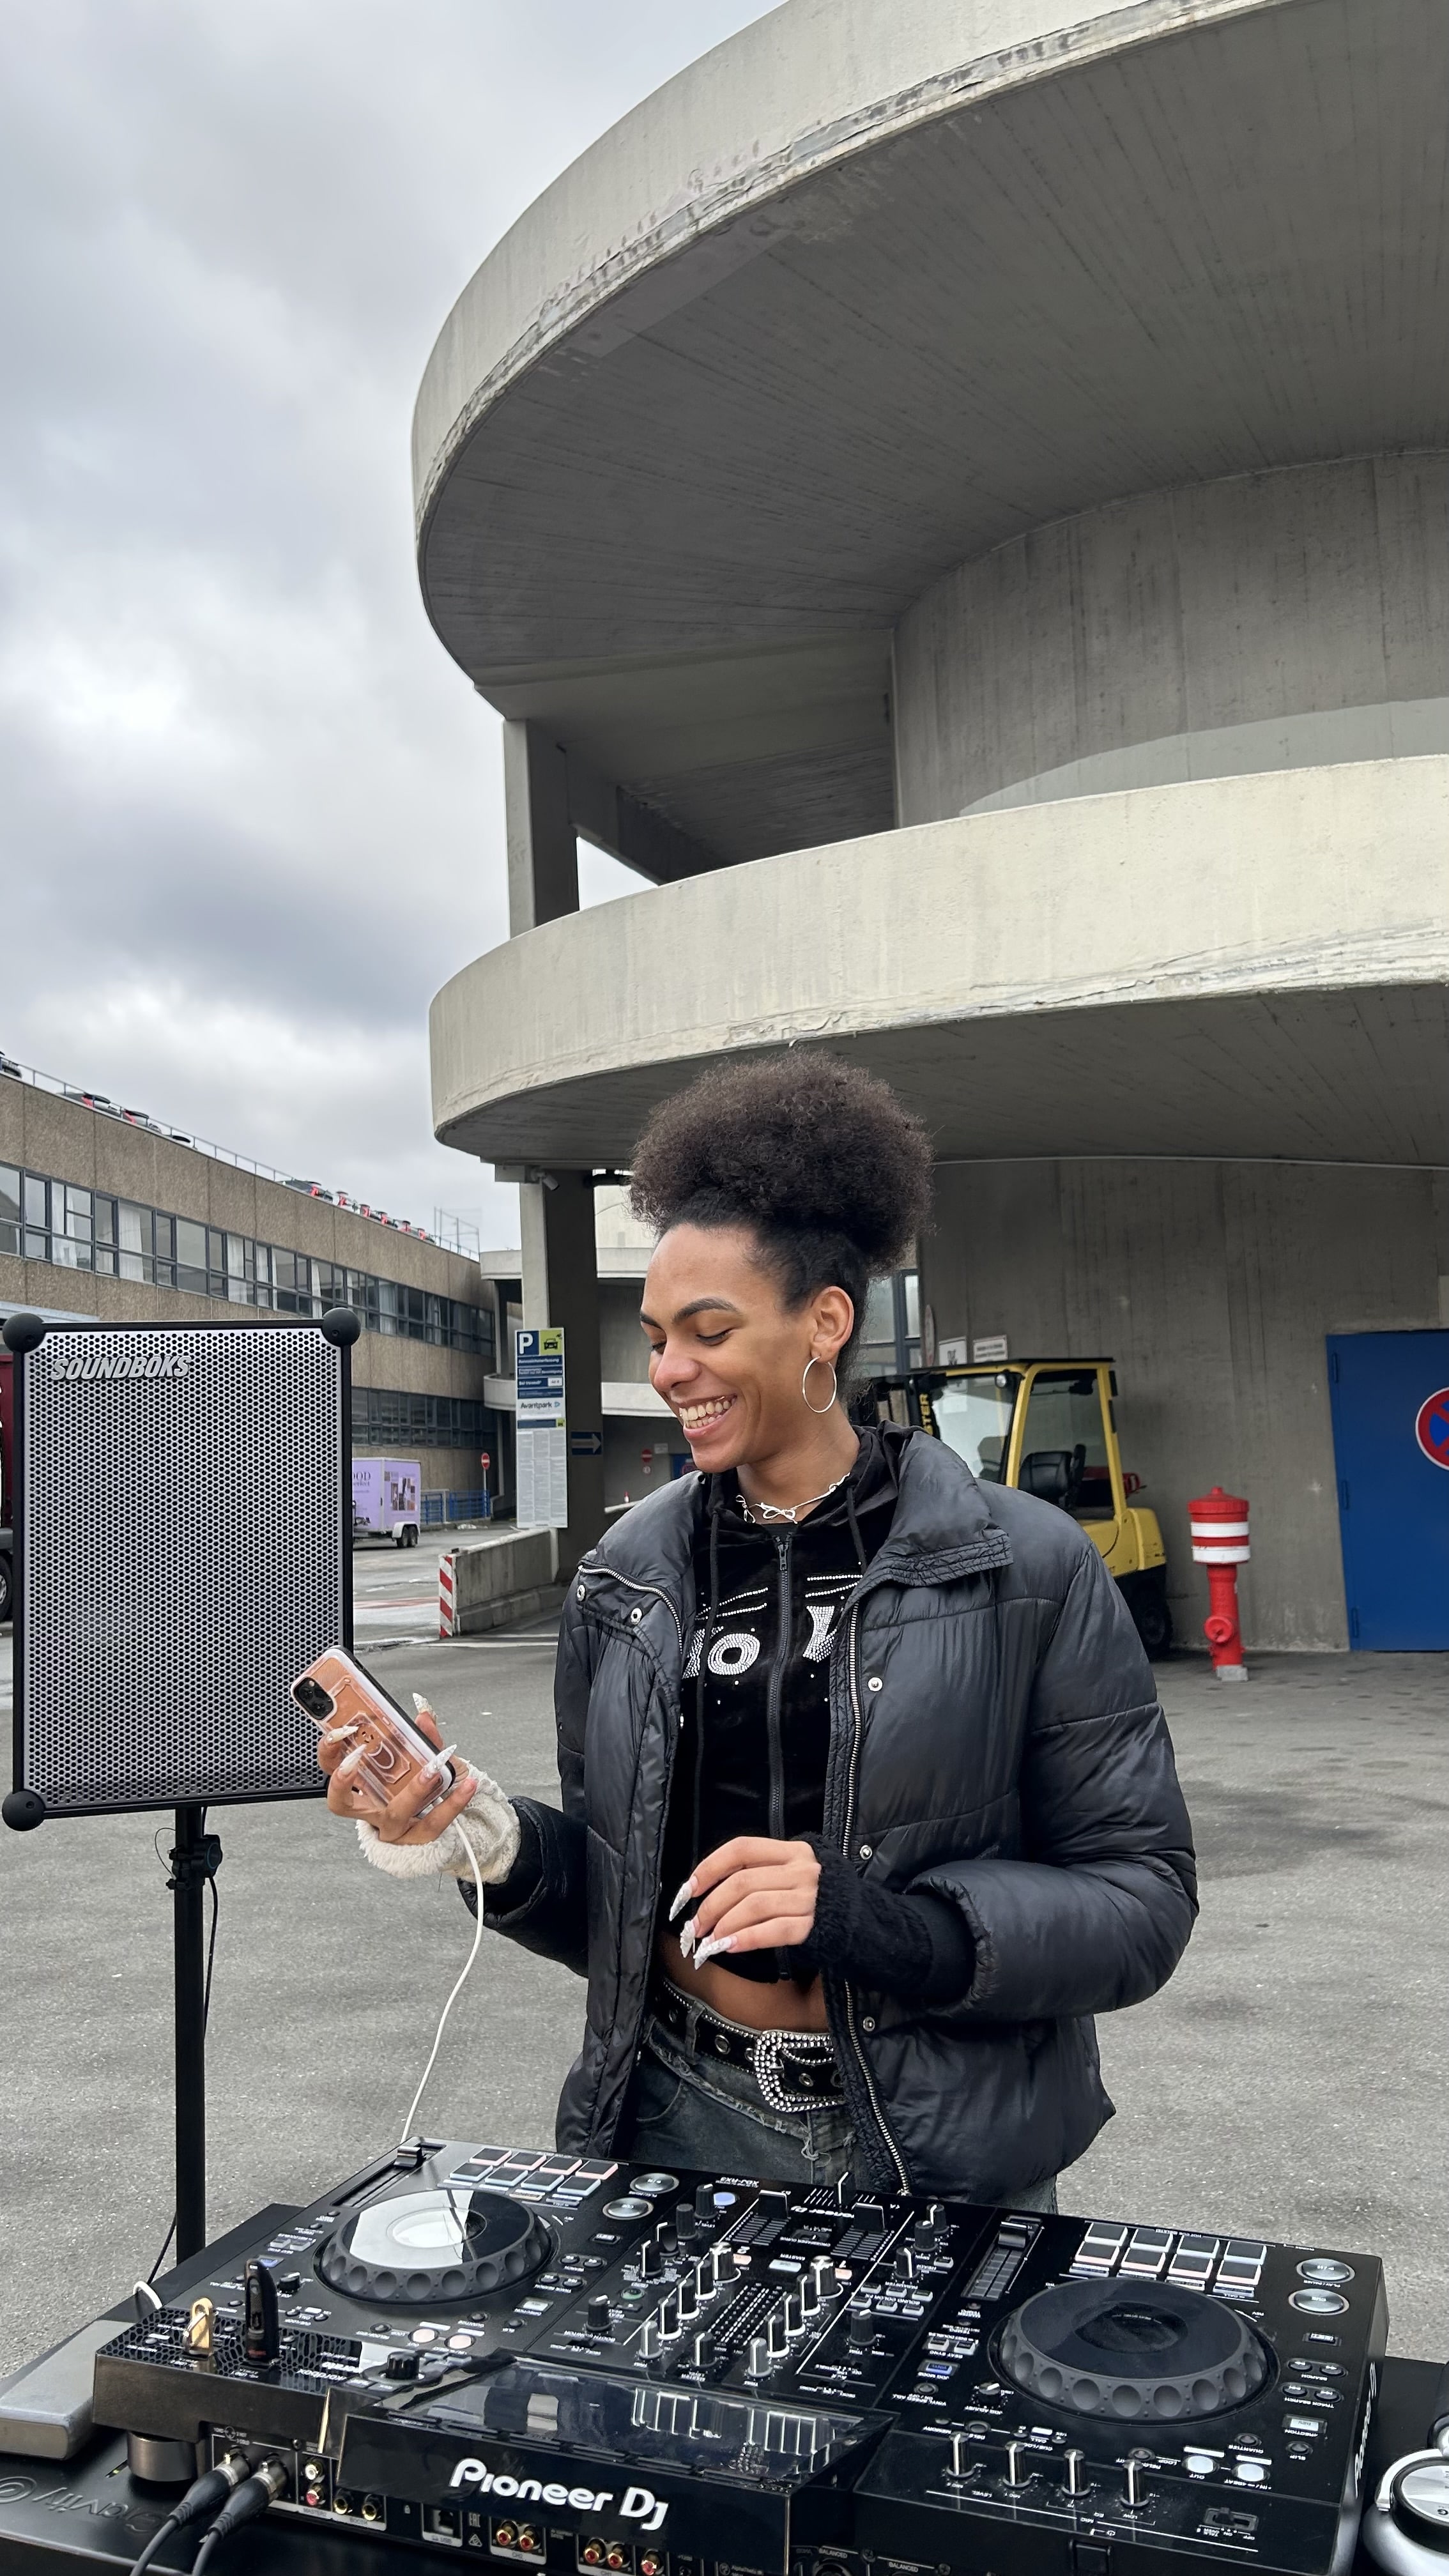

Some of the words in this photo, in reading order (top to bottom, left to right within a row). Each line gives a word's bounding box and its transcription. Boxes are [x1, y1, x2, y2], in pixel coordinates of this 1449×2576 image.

[519, 1333, 533, 1354] P
[51, 1356, 192, 1381] SOUNDBOKS
[1023, 2442, 1053, 2452] CUE/LO
[450, 2458, 613, 2511] Pioneer
[618, 2485, 669, 2531] DJ
[818, 2547, 848, 2559] BALANCED
[889, 2561, 919, 2573] BALANCED
